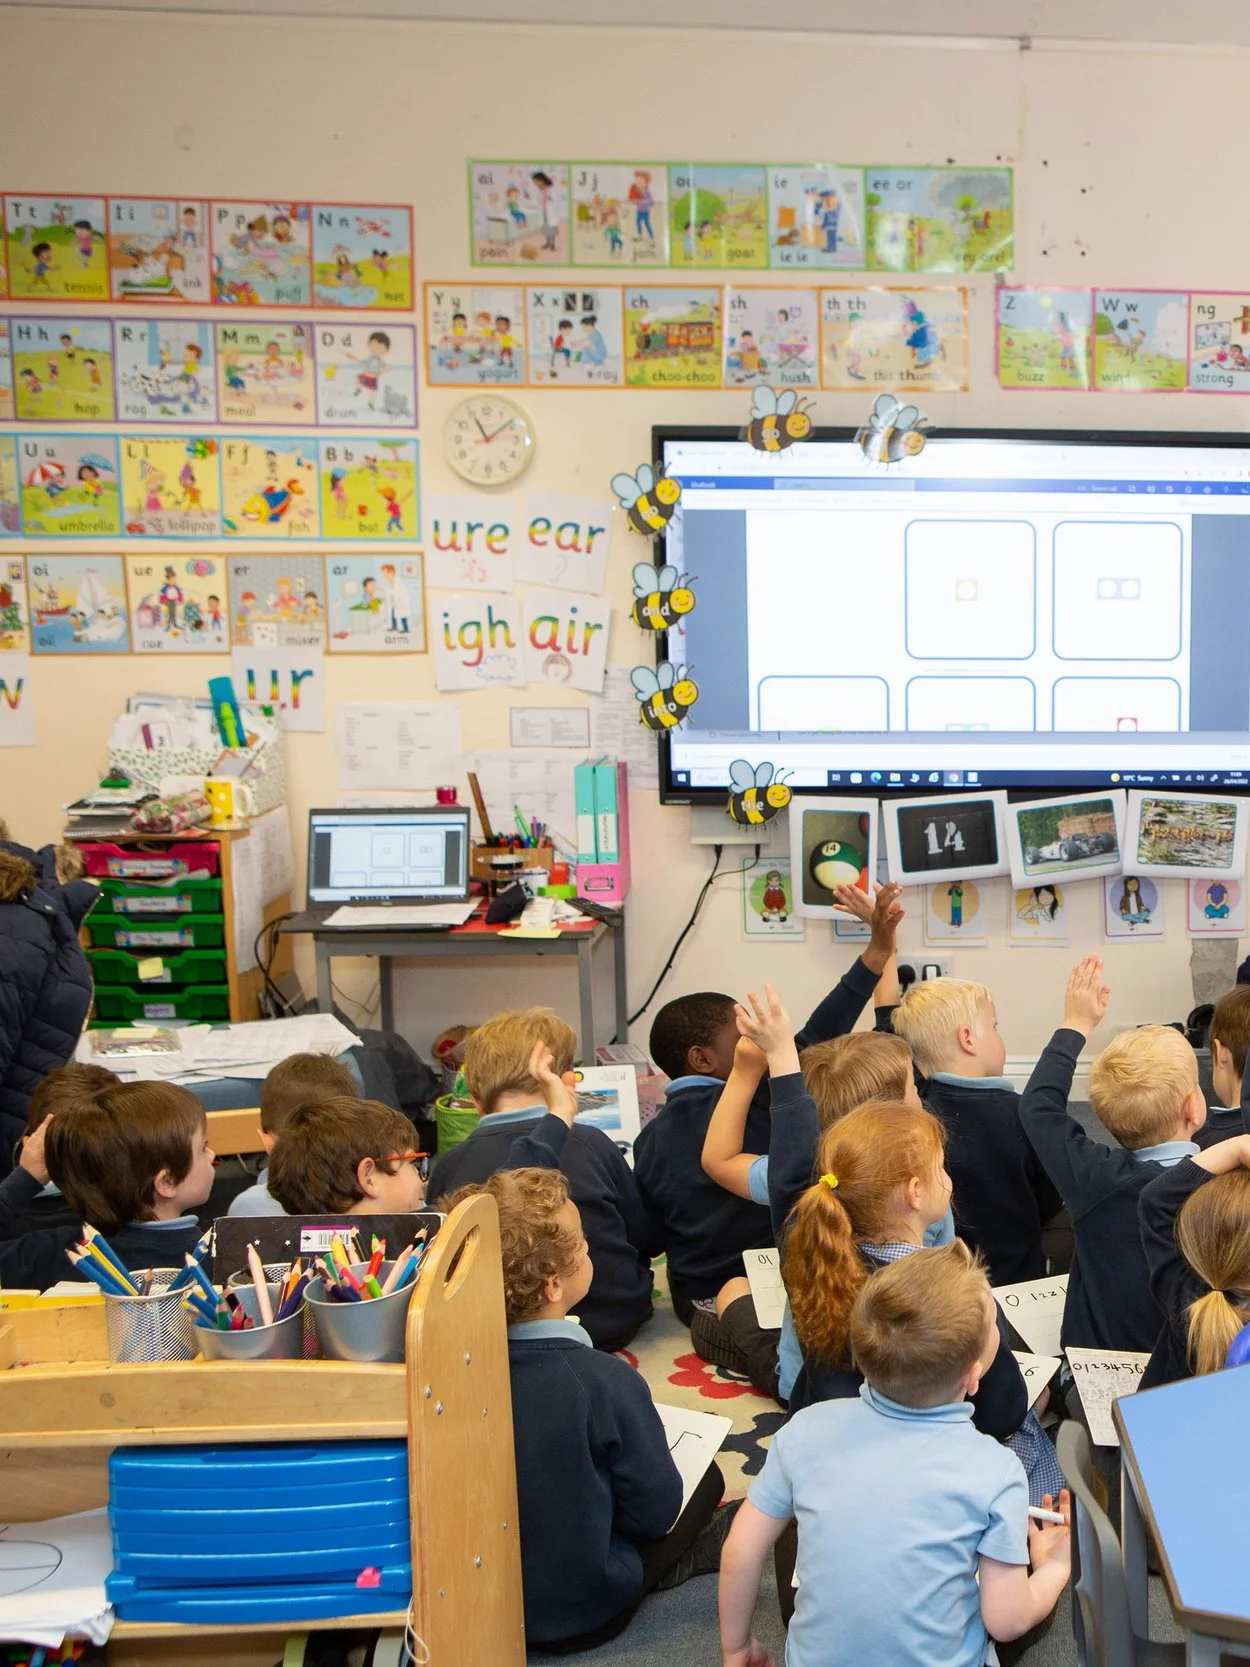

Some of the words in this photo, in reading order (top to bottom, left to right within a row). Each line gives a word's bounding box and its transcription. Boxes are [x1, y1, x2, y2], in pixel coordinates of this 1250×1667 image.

[775, 178, 787, 189] ie
[12, 203, 25, 219] T
[30, 205, 36, 218] t
[217, 209, 228, 224] P
[235, 212, 246, 227] p
[317, 210, 332, 227] N
[339, 215, 349, 227] n
[434, 292, 444, 304] Y
[451, 297, 460, 310] y
[534, 292, 544, 307] X
[552, 298, 559, 308] x
[631, 293, 649, 308] ch
[731, 296, 747, 309] sh
[827, 297, 841, 310] th
[848, 297, 866, 310] th
[1005, 296, 1015, 310] Z
[1103, 299, 1119, 312] W
[1126, 303, 1138, 312] w
[1197, 305, 1215, 319] ng
[18, 326, 31, 340] H
[38, 327, 49, 341] h
[122, 328, 133, 342] R
[140, 331, 147, 341] r
[223, 330, 238, 345] M
[245, 334, 260, 345] m
[322, 332, 335, 347] D
[342, 333, 352, 349] d
[478, 367, 518, 382] yogurt
[651, 370, 716, 382] choo-choo
[781, 372, 810, 384] hush
[1018, 372, 1044, 381] buzz
[1195, 373, 1233, 386] strong
[73, 402, 100, 418] hop
[25, 443, 37, 457] U
[45, 446, 55, 458] u
[127, 444, 136, 459] L
[227, 444, 236, 460] F
[243, 445, 249, 465] f
[326, 448, 337, 461] B
[344, 448, 353, 462] b
[59, 519, 115, 532] umbrella
[168, 519, 216, 537] lollipop
[432, 519, 510, 554] ure
[528, 516, 605, 554] ear
[34, 565, 49, 577] oi
[234, 565, 251, 576] er
[333, 565, 349, 576] ar
[642, 602, 671, 617] and
[442, 604, 516, 667] igh
[529, 606, 602, 656] air
[384, 635, 410, 645] arm
[648, 701, 677, 719] into
[741, 799, 765, 812] the
[924, 820, 966, 855] 14
[825, 843, 837, 853] 14
